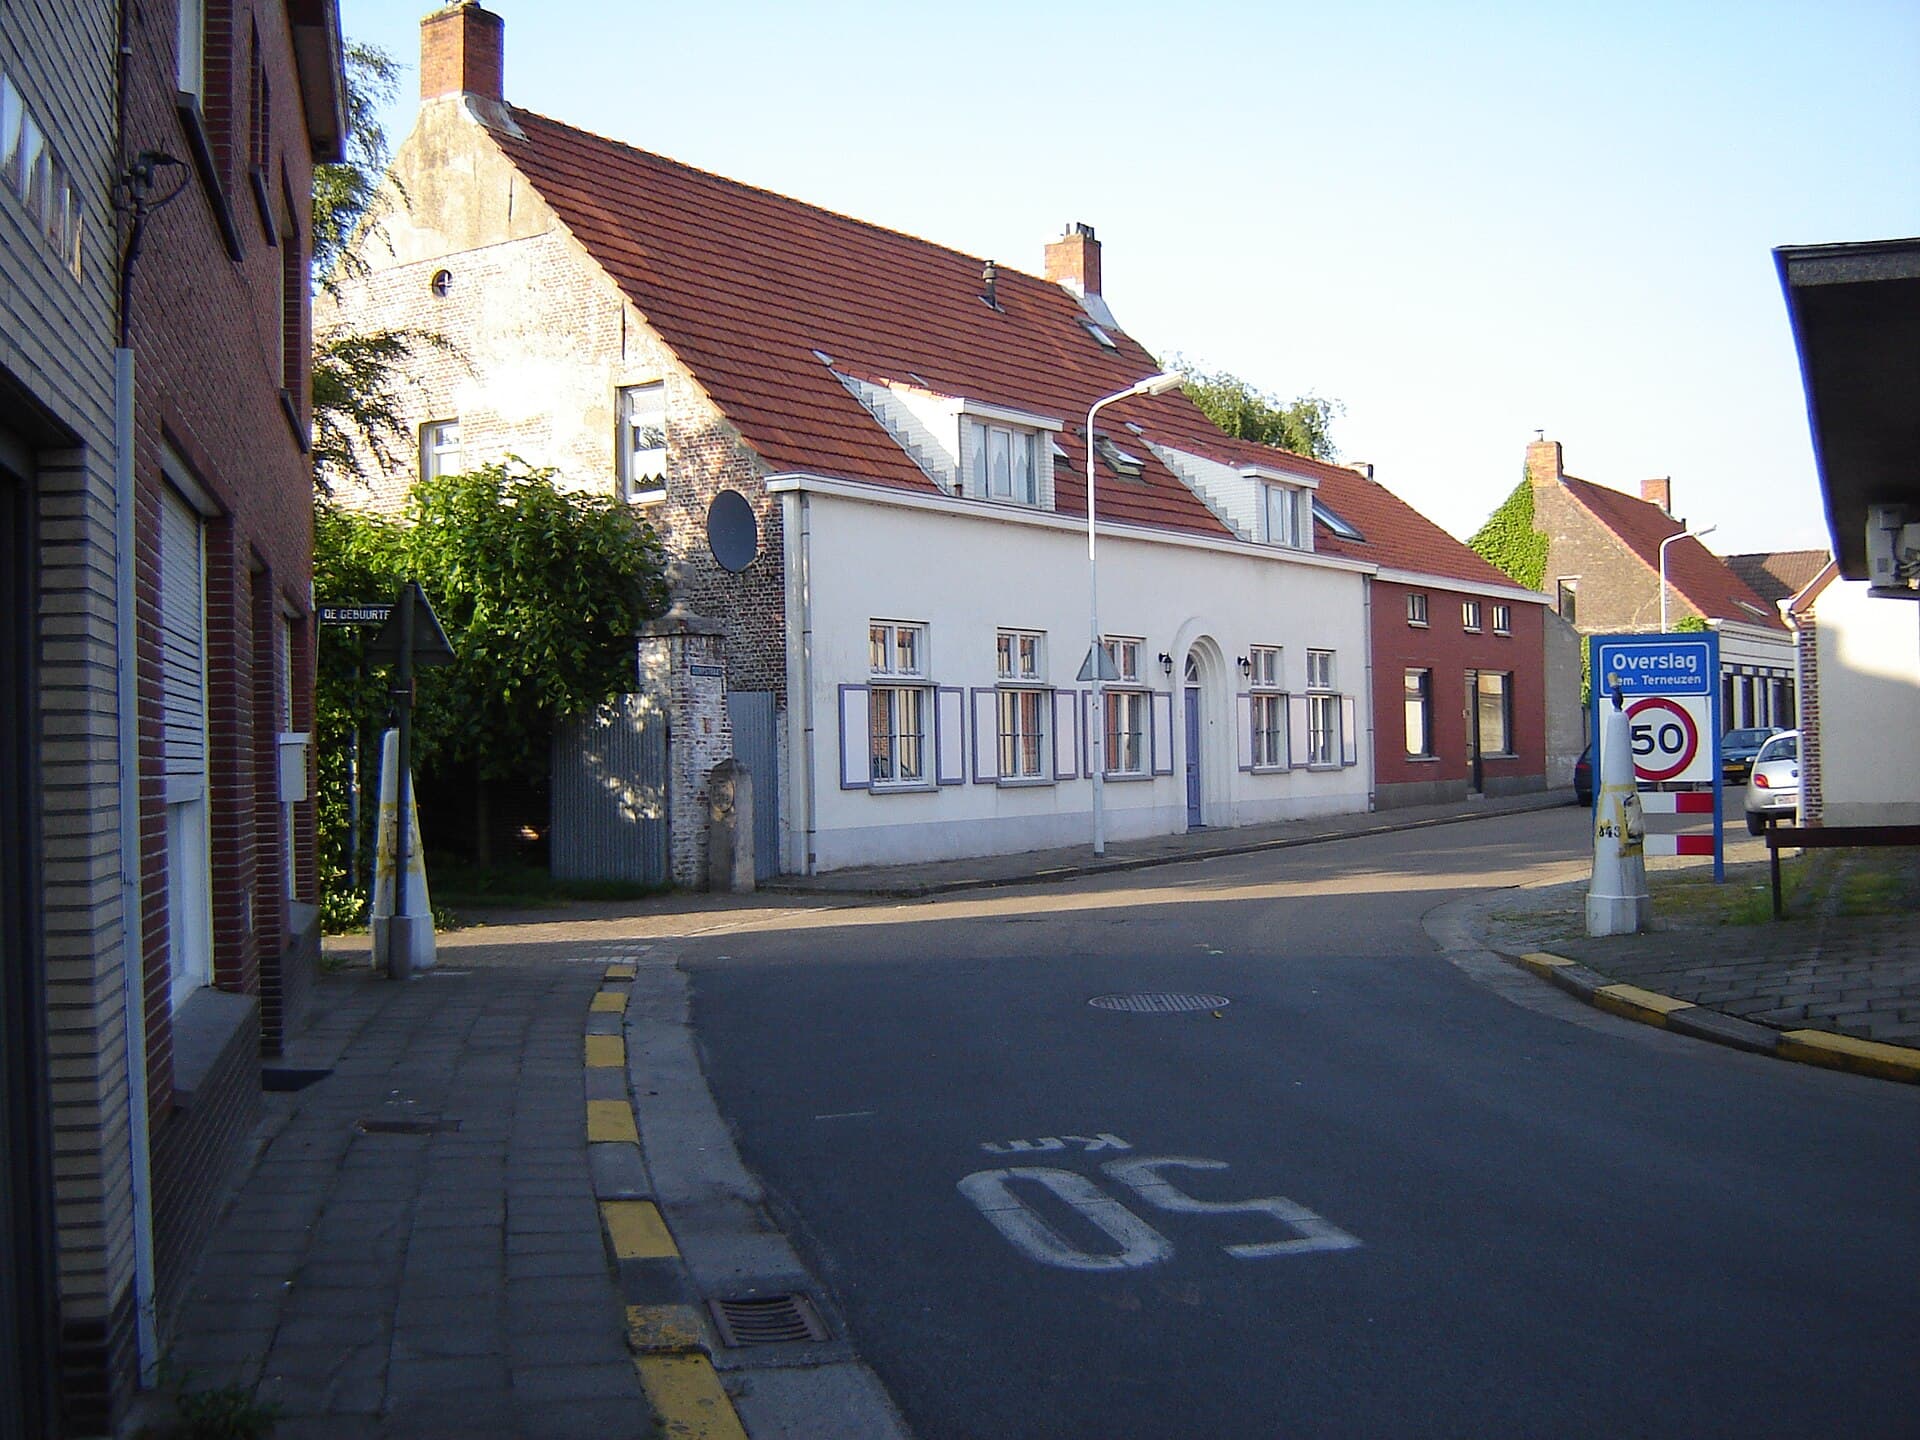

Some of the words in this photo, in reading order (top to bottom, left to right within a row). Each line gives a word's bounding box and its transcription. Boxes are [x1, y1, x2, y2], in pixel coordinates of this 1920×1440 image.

[324, 609, 337, 619] DE
[1612, 652, 1697, 673] Overslag
[1616, 677, 1637, 686] em.
[1641, 675, 1701, 686] Terneuzen
[1631, 723, 1684, 755] 50
[956, 1157, 1363, 1270] 50
